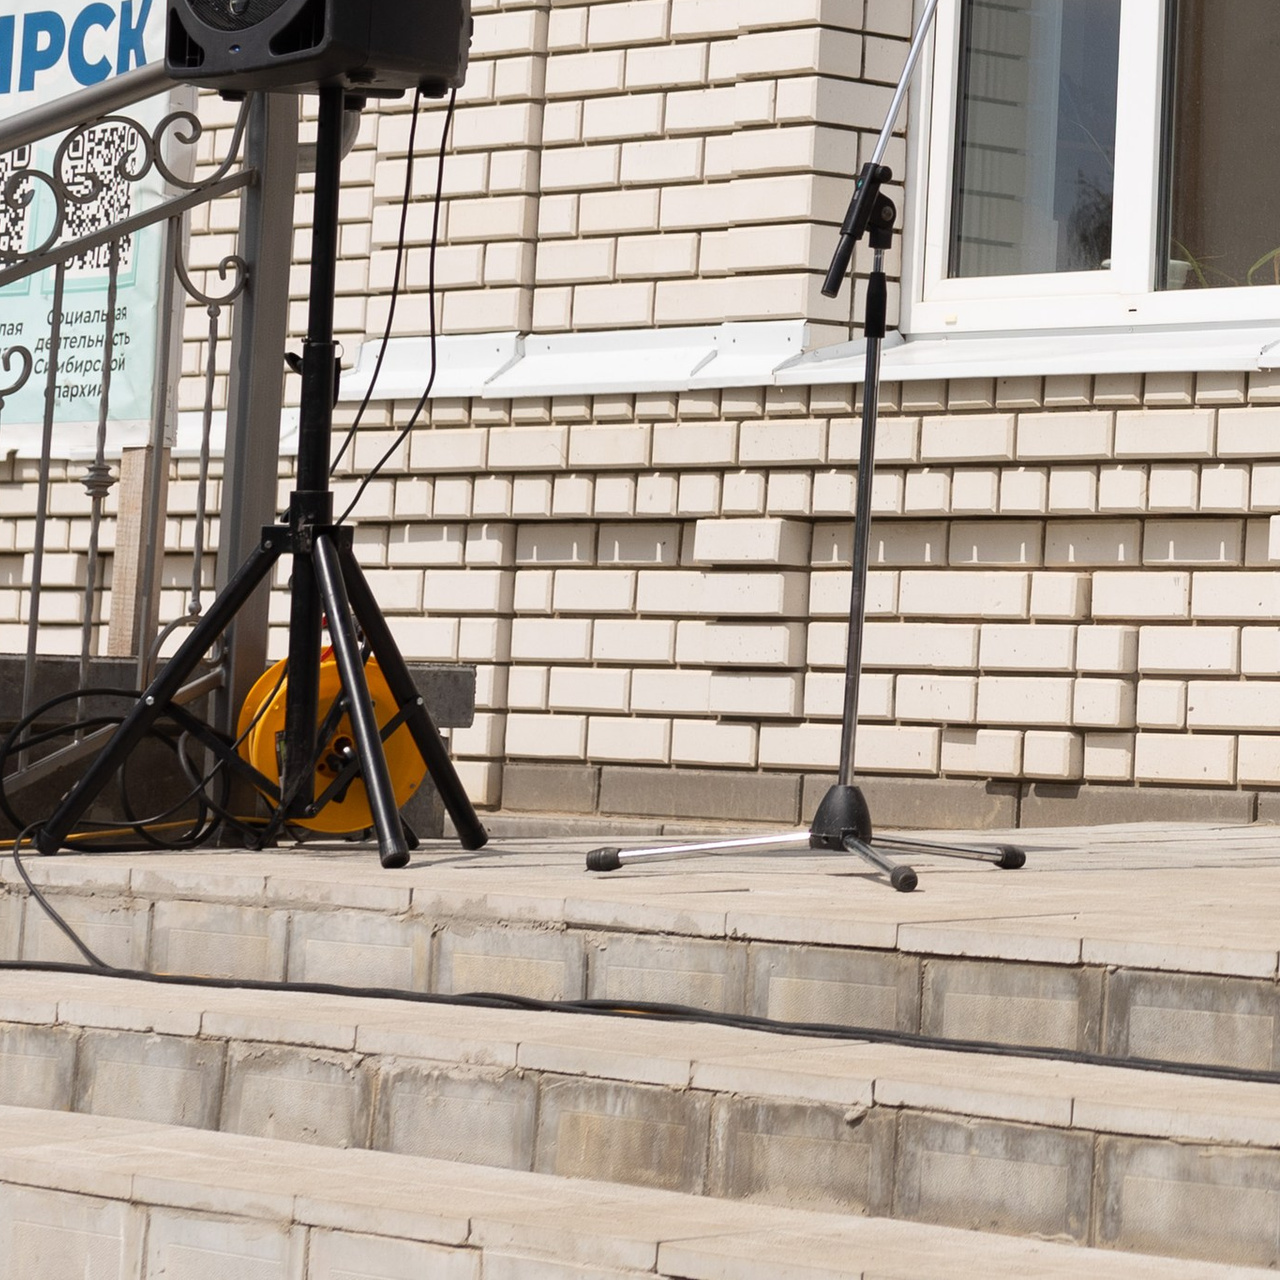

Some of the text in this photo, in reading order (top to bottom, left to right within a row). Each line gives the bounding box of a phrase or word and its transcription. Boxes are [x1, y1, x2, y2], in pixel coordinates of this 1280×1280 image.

[47, 307, 127, 327] Сциальая
[34, 332, 130, 353] детельнсть
[34, 353, 125, 377] Симбирсой
